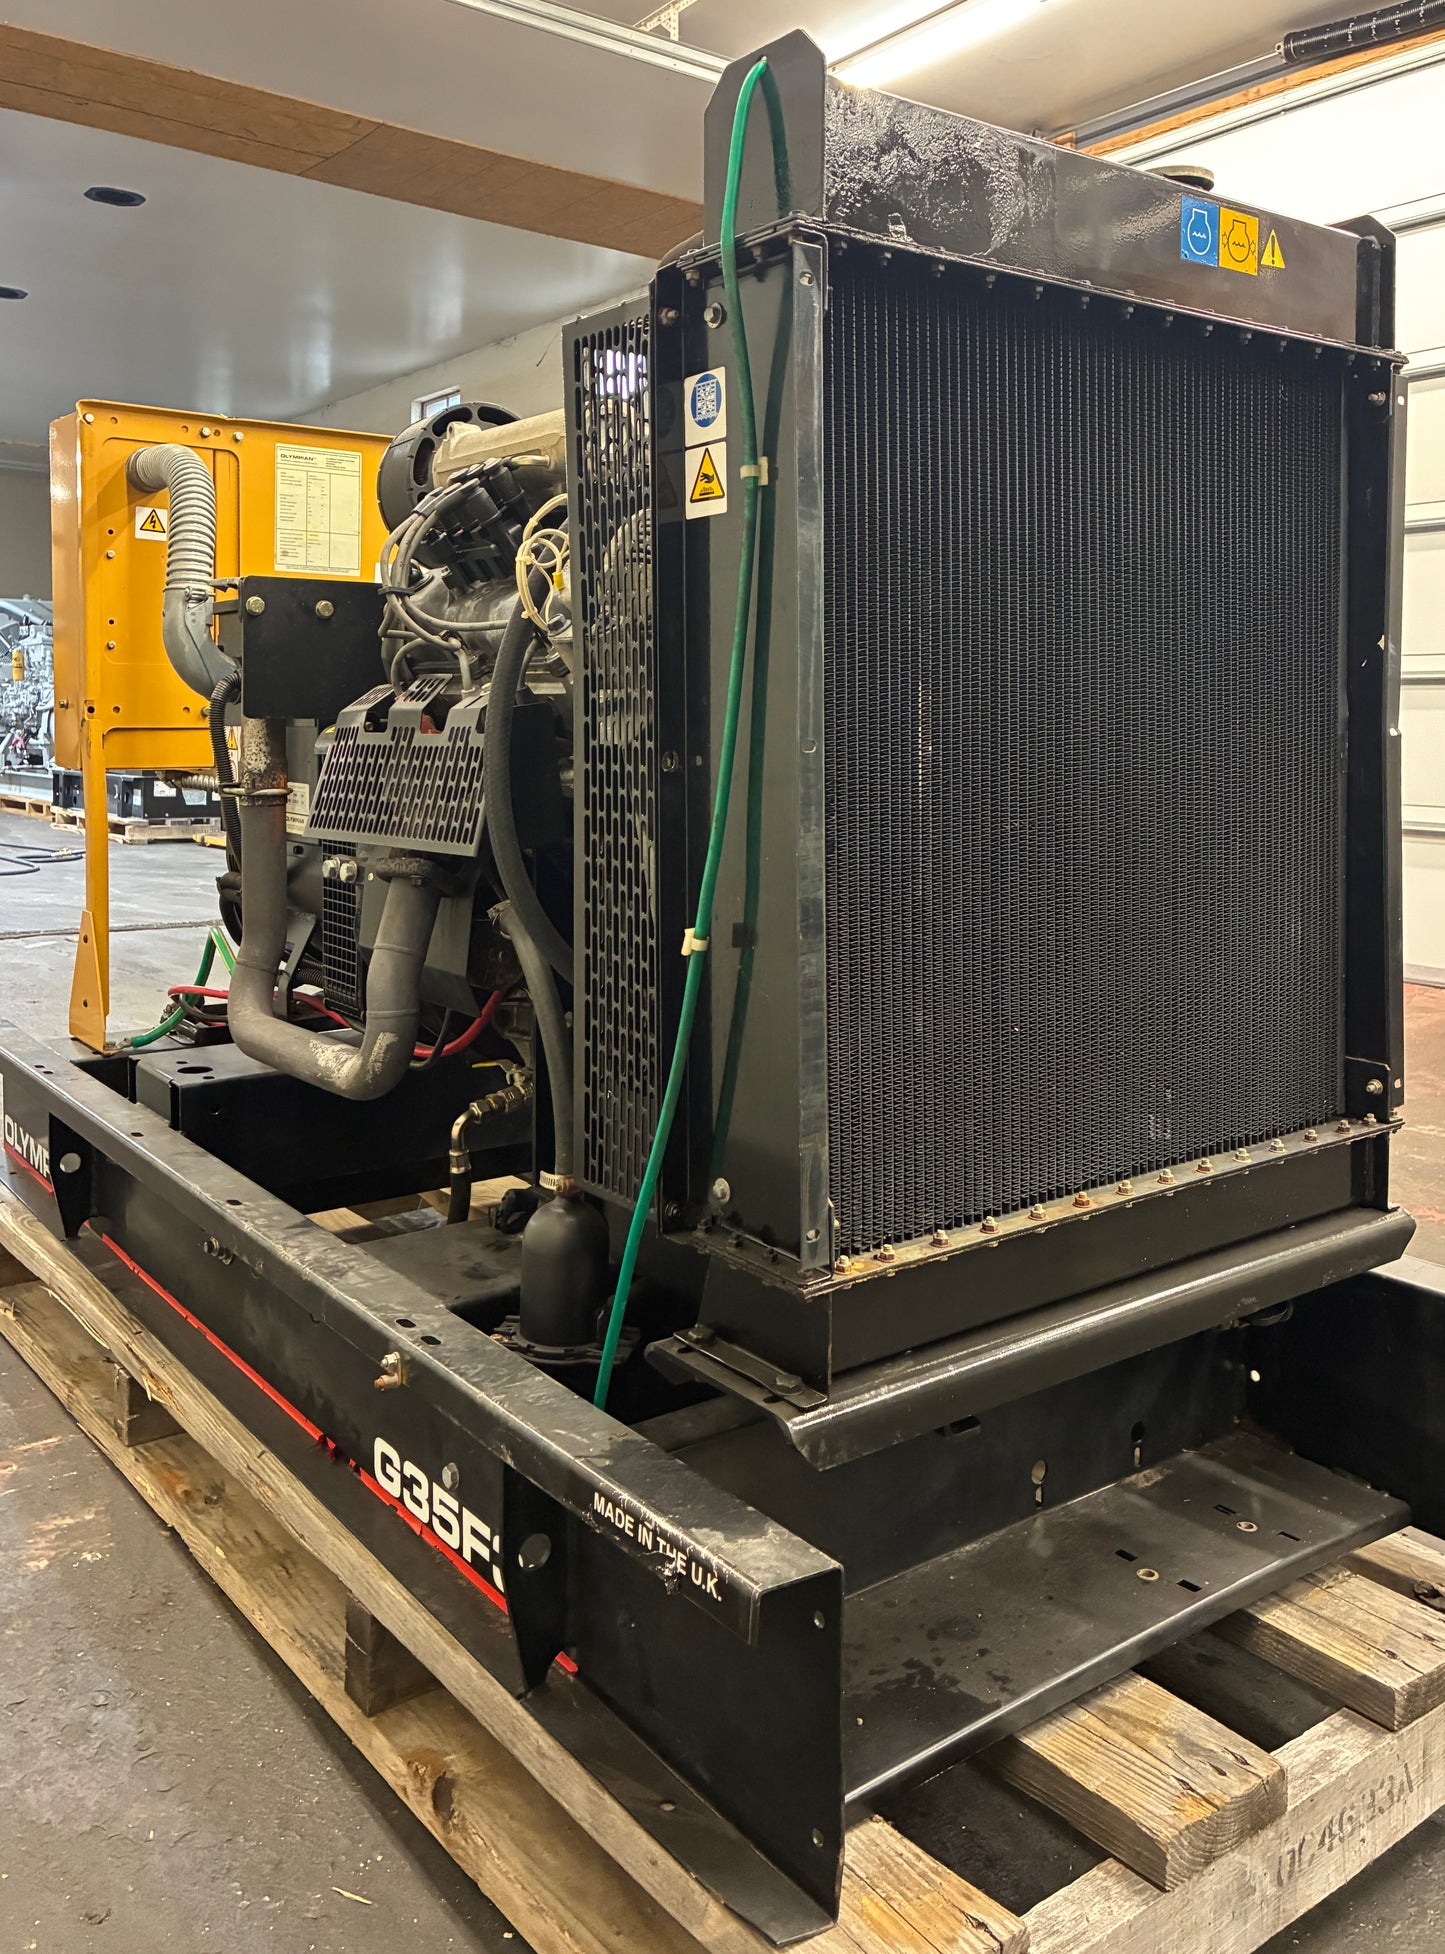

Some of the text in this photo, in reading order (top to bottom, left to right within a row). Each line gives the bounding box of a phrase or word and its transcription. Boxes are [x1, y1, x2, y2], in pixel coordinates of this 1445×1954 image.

[593, 1491, 722, 1603] MADE IN THE U.K.
